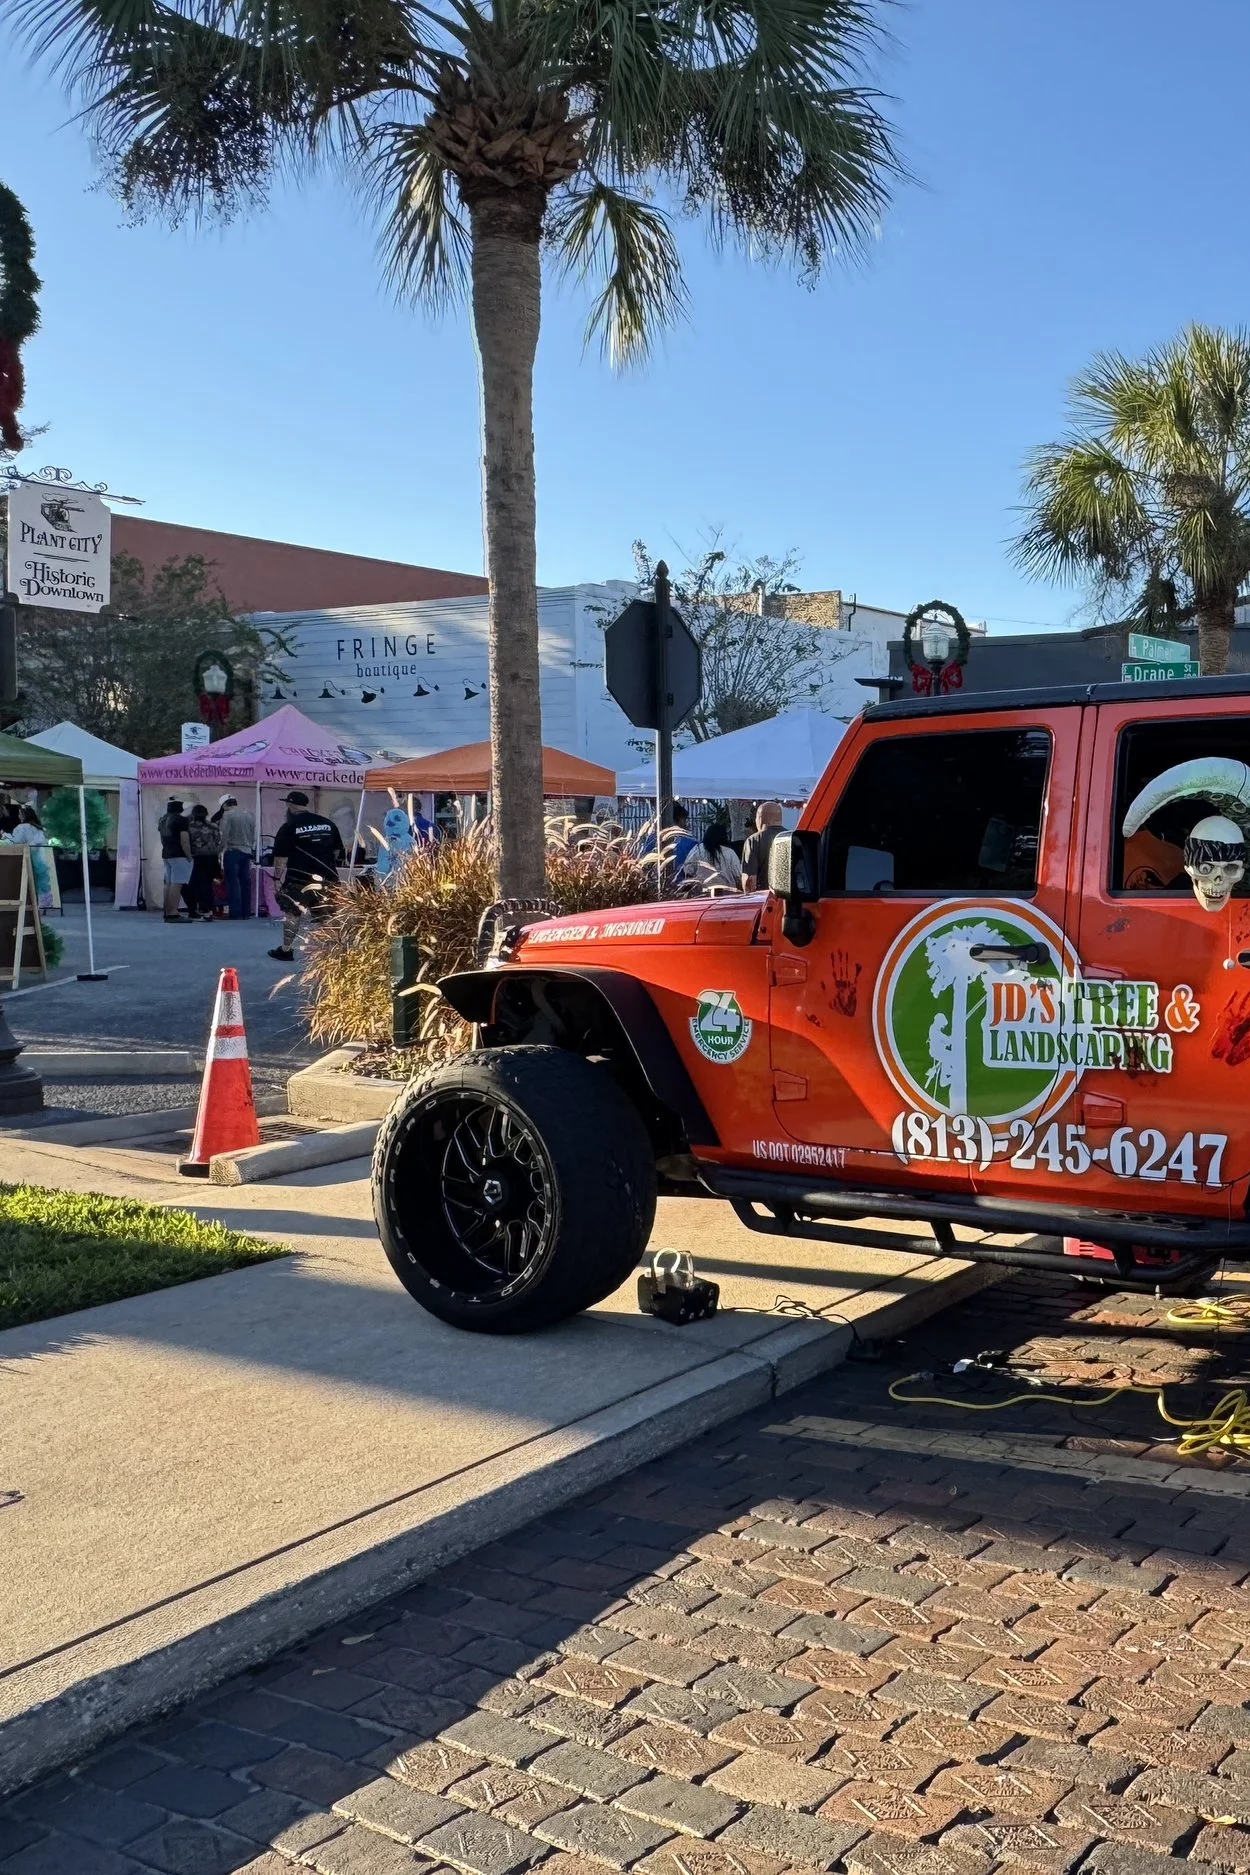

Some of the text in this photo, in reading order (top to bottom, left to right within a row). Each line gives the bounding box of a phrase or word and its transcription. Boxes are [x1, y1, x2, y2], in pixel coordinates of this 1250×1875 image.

[20, 521, 103, 554] PLANT CITY
[25, 560, 96, 588] Historic
[20, 578, 104, 603] Downtown
[337, 633, 436, 661] FRINGE
[1142, 638, 1175, 658] Palmer
[356, 663, 417, 680] boutique
[1134, 666, 1175, 682] Drane
[265, 767, 364, 785] www.crackede
[699, 991, 741, 1033] 24
[989, 982, 1201, 1032] JD'S TREE &
[707, 1035, 734, 1045] HOUR
[729, 1020, 750, 1058] SERVICE
[989, 1029, 1170, 1071] LANDSCAPING
[752, 1139, 846, 1169] US DOT 02952417
[891, 1111, 1228, 1188] (813)-245-6247
